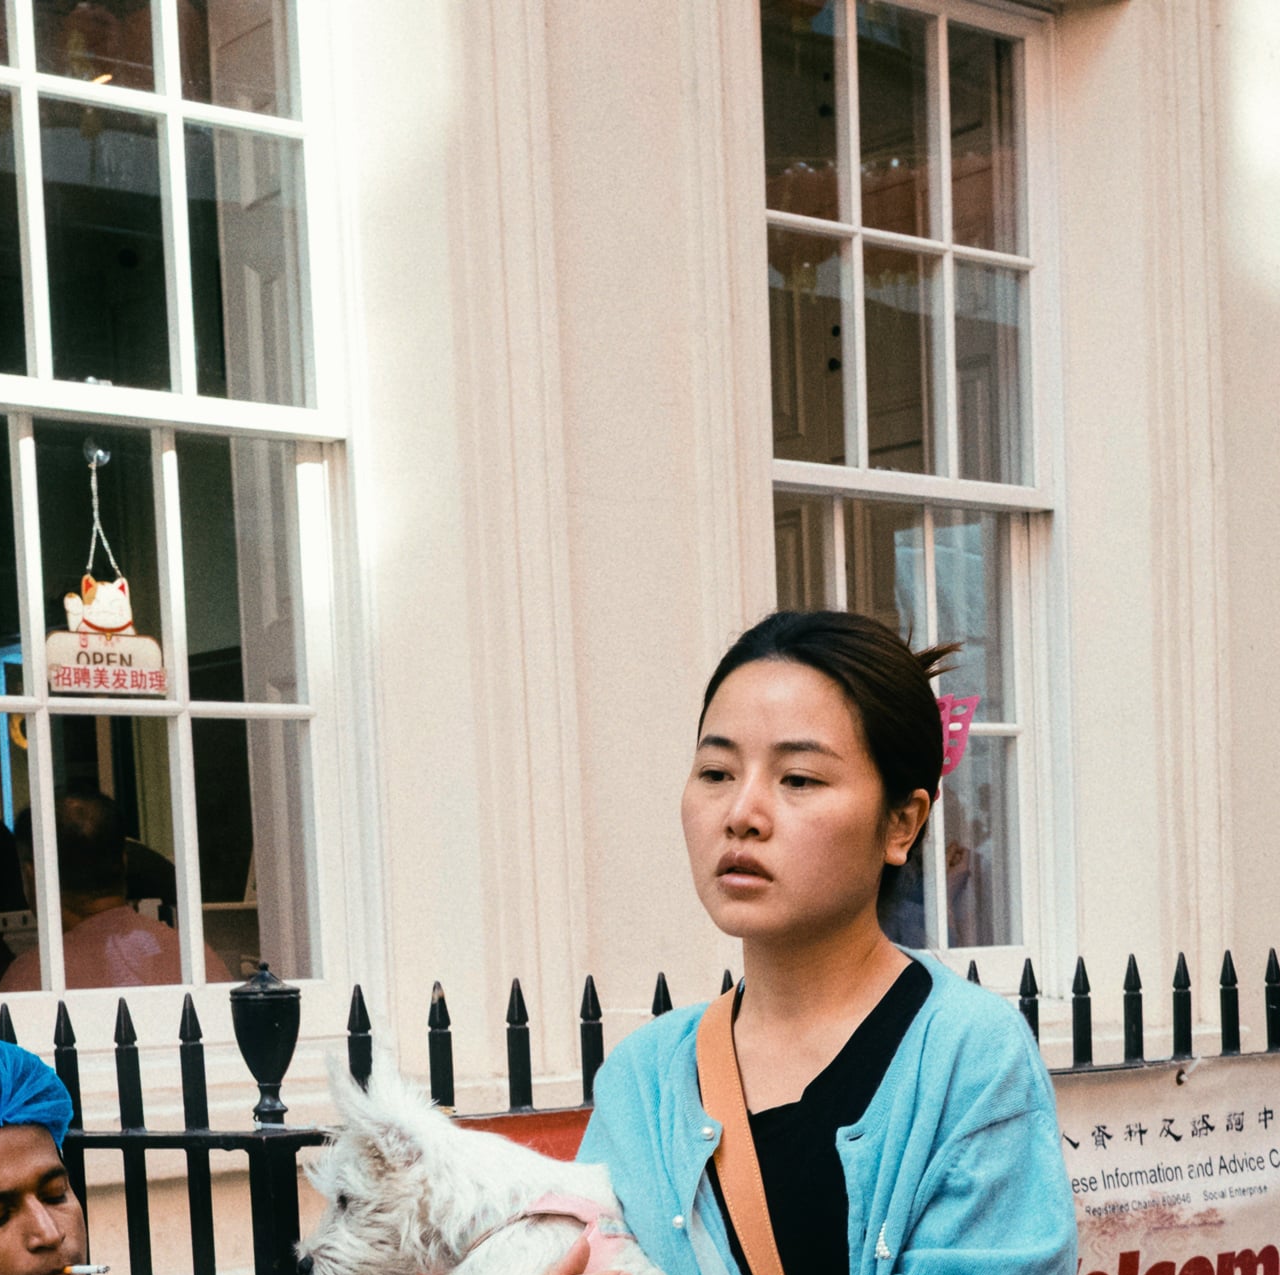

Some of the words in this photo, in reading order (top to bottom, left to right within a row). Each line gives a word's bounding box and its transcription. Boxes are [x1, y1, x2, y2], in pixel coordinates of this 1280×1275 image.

[53, 666, 166, 691] 招聘美发助理
[1101, 1160, 1185, 1190] Information
[1188, 1159, 1215, 1181] and
[1218, 1151, 1266, 1177] Advice
[1085, 1201, 1129, 1217] Registered
[1131, 1198, 1160, 1213] Charity
[1203, 1188, 1227, 1202] Social
[1229, 1184, 1268, 1200] Enterprise
